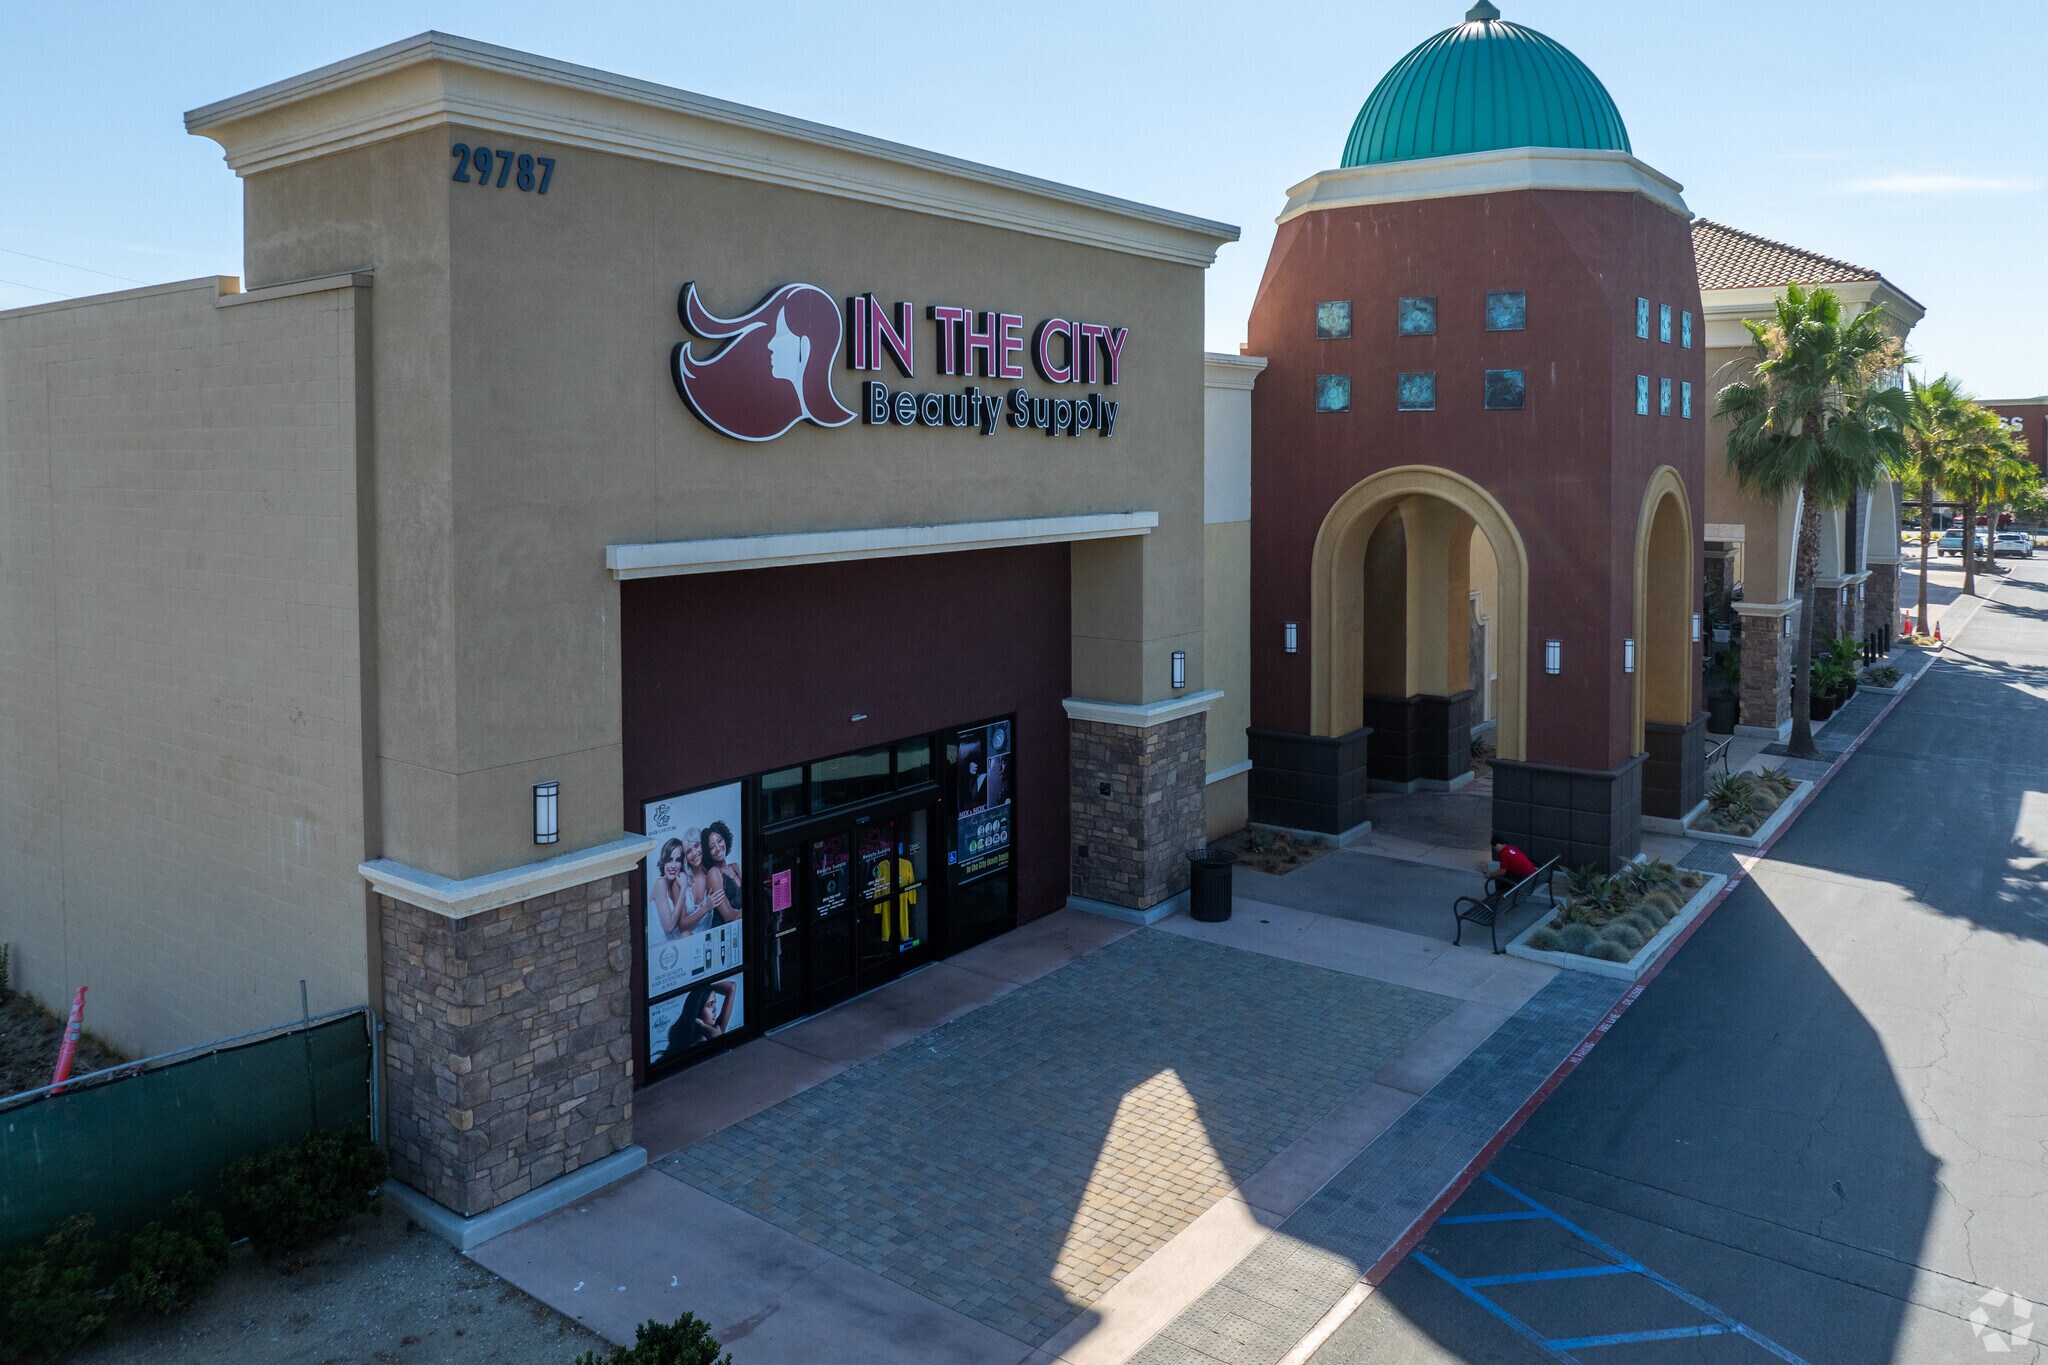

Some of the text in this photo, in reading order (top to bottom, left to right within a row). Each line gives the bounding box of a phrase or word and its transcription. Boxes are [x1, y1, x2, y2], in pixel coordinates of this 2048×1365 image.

[453, 143, 556, 194] 29787
[846, 292, 1128, 385] IN THE CITY
[862, 381, 1120, 438] Beauty Supply
[666, 967, 683, 977] QUALITY
